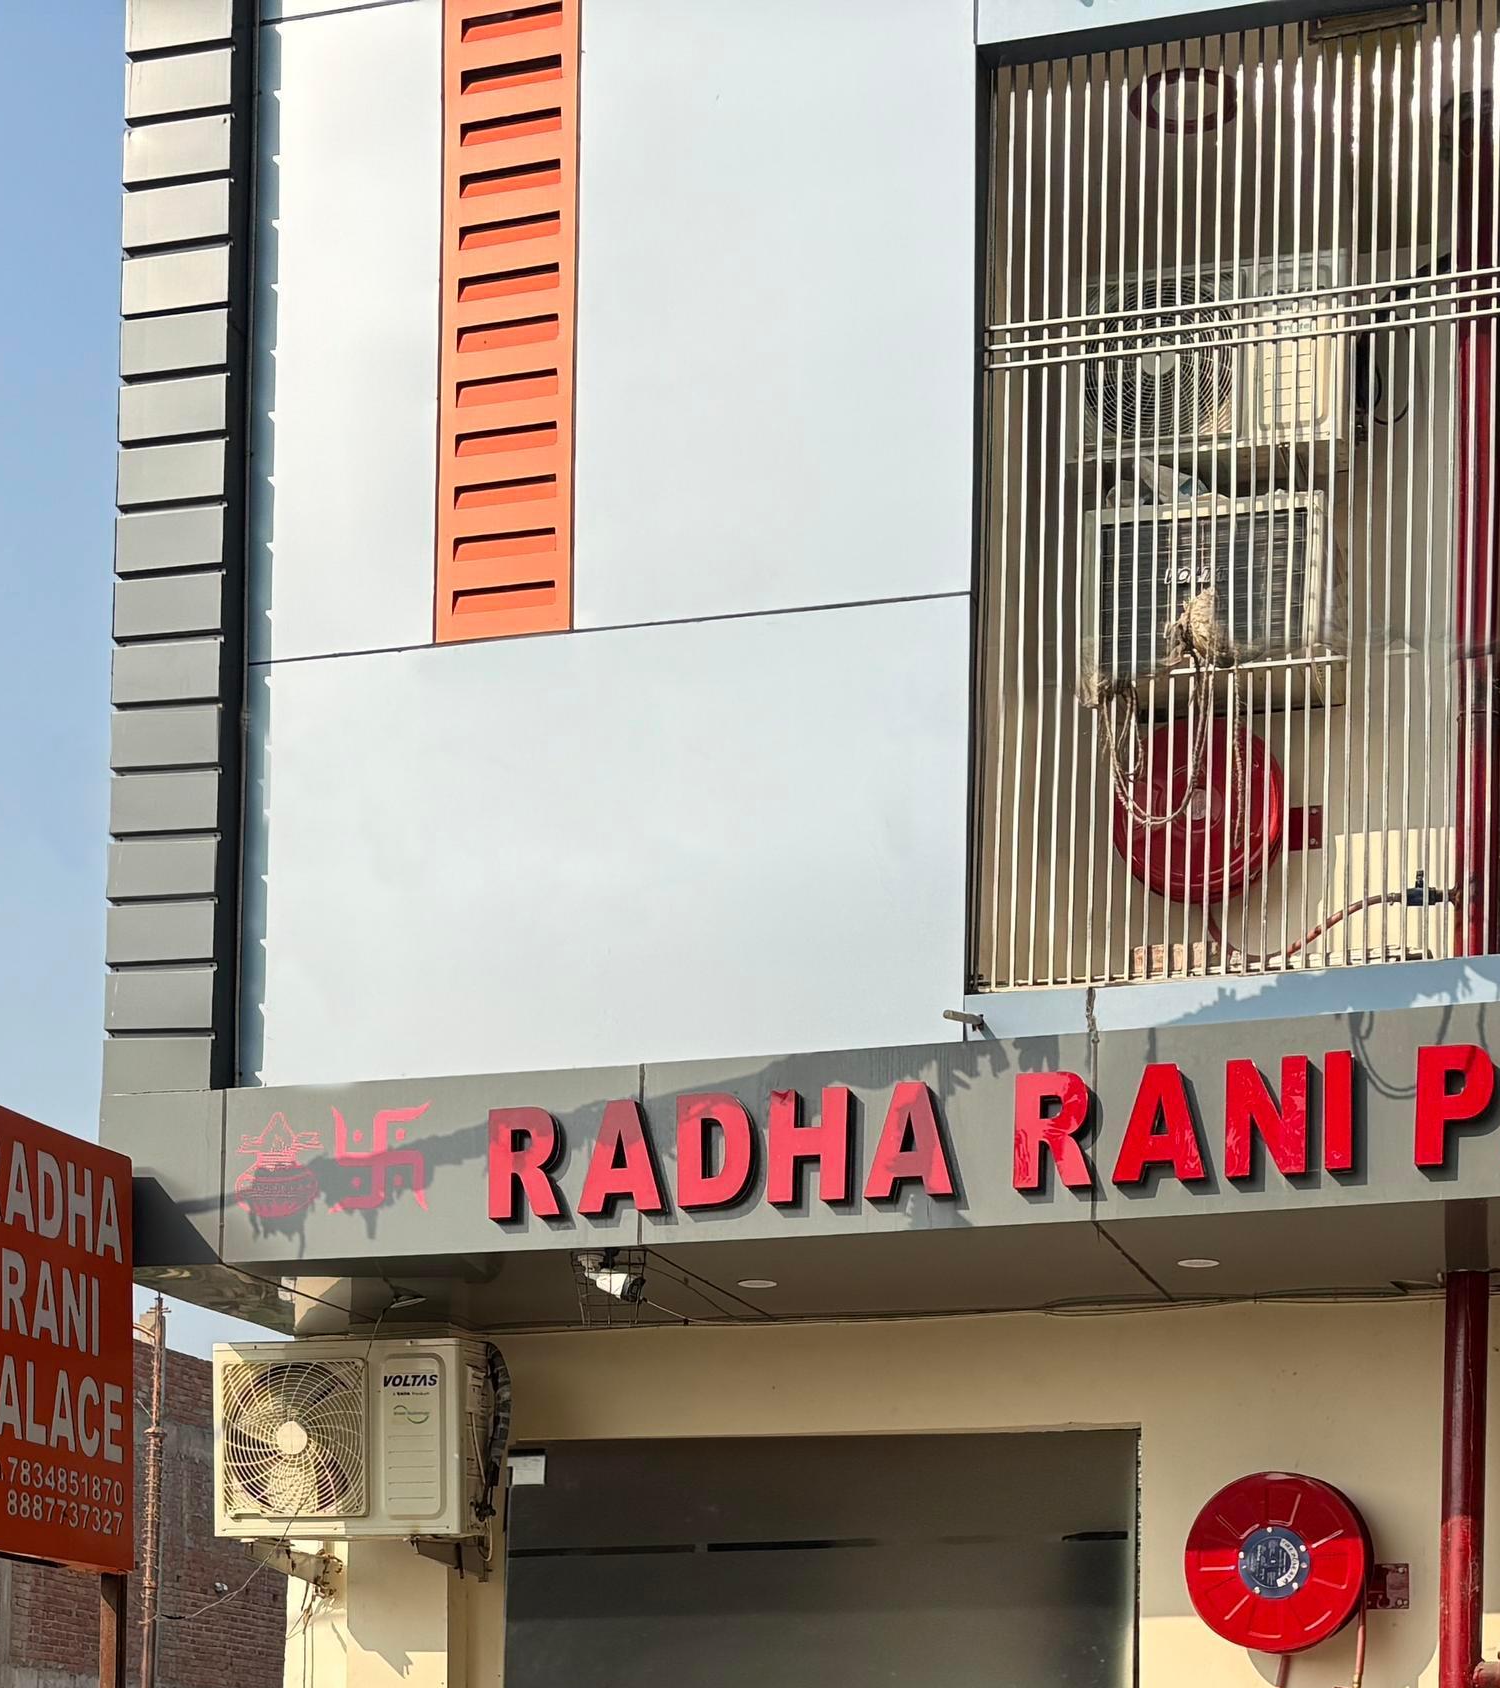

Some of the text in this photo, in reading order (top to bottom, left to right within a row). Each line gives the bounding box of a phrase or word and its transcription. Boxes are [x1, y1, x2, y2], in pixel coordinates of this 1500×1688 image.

[487, 1080, 956, 1222] RADHA
[1013, 1050, 1354, 1190] RANI
[1, 1247, 100, 1357] RANI
[383, 1374, 438, 1388] VOLTAS
[7, 1456, 123, 1507] 7834851870
[6, 1489, 124, 1537] 8887737327
